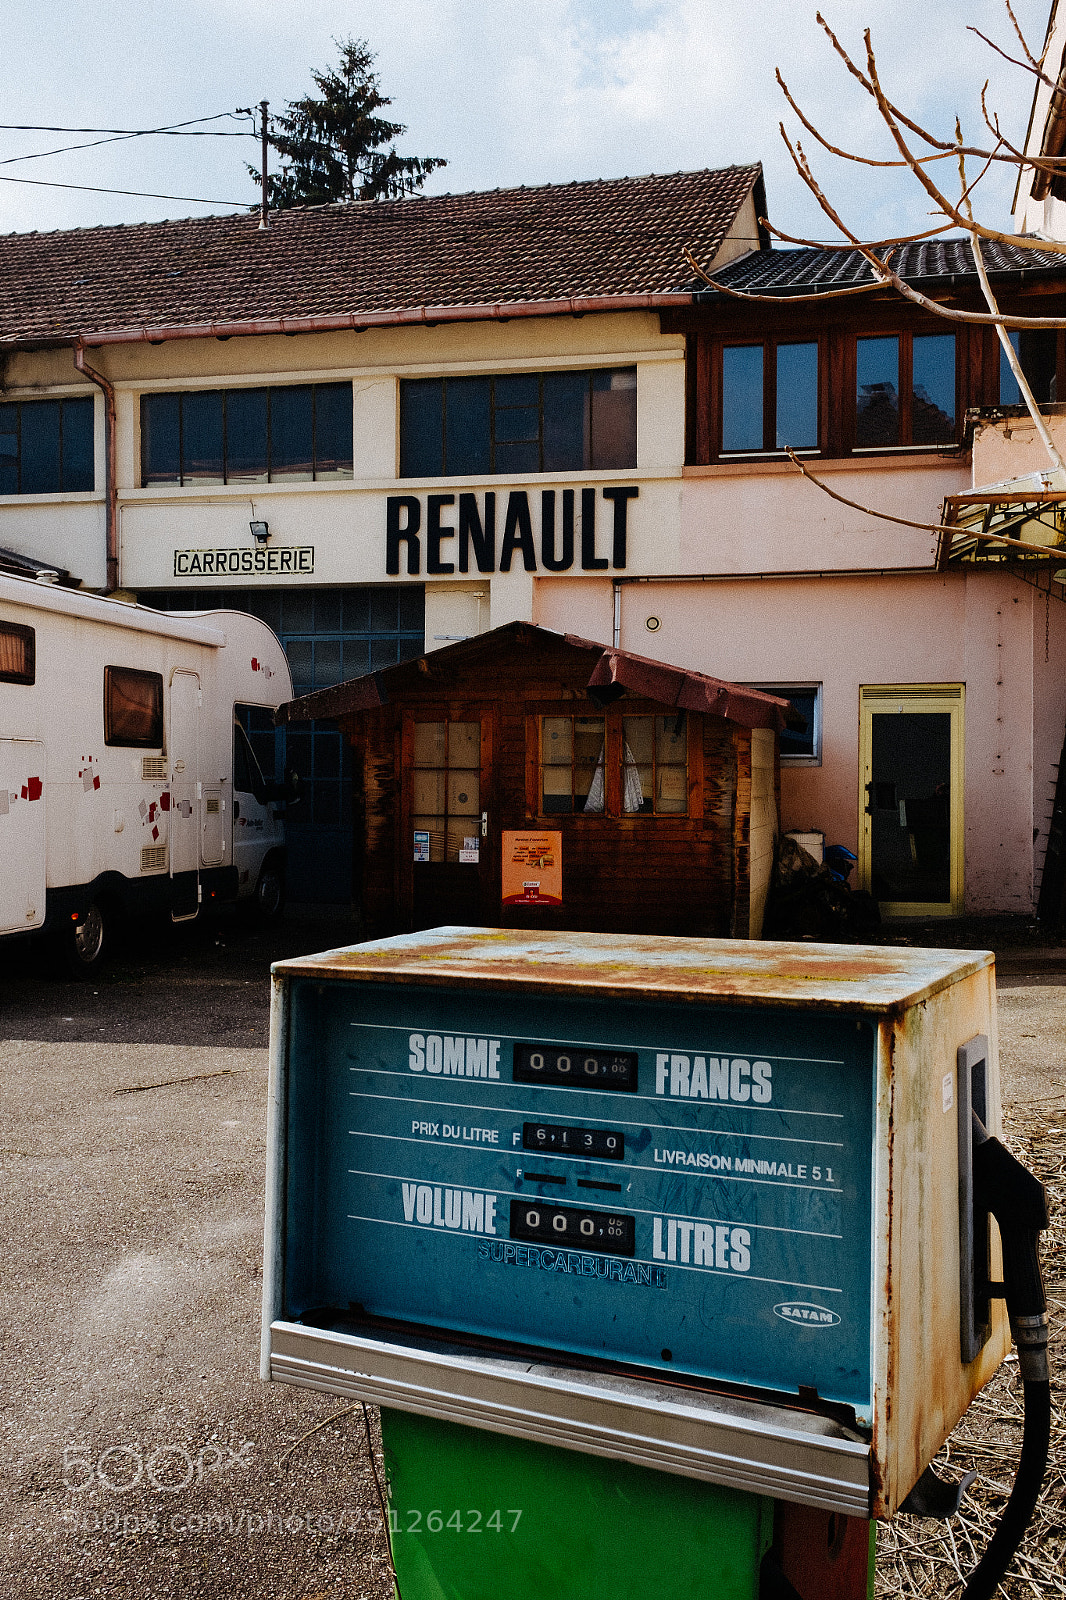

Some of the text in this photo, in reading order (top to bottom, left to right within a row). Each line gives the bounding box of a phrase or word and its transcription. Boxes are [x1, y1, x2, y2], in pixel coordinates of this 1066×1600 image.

[386, 486, 639, 575] RENAULT
[177, 550, 311, 573] CARROSSERIE
[408, 1033, 501, 1079] SOMME
[655, 1053, 773, 1104] FRANCS
[411, 1120, 440, 1137] PRIX
[442, 1124, 461, 1139] DU
[462, 1126, 500, 1144] LITRE
[512, 1132, 521, 1146] F
[653, 1148, 732, 1171] LIVRAISON
[734, 1157, 807, 1179] MINIMALE
[401, 1182, 497, 1235] VOLUME
[652, 1217, 751, 1272] LITRES
[781, 1306, 833, 1323] SATAM
